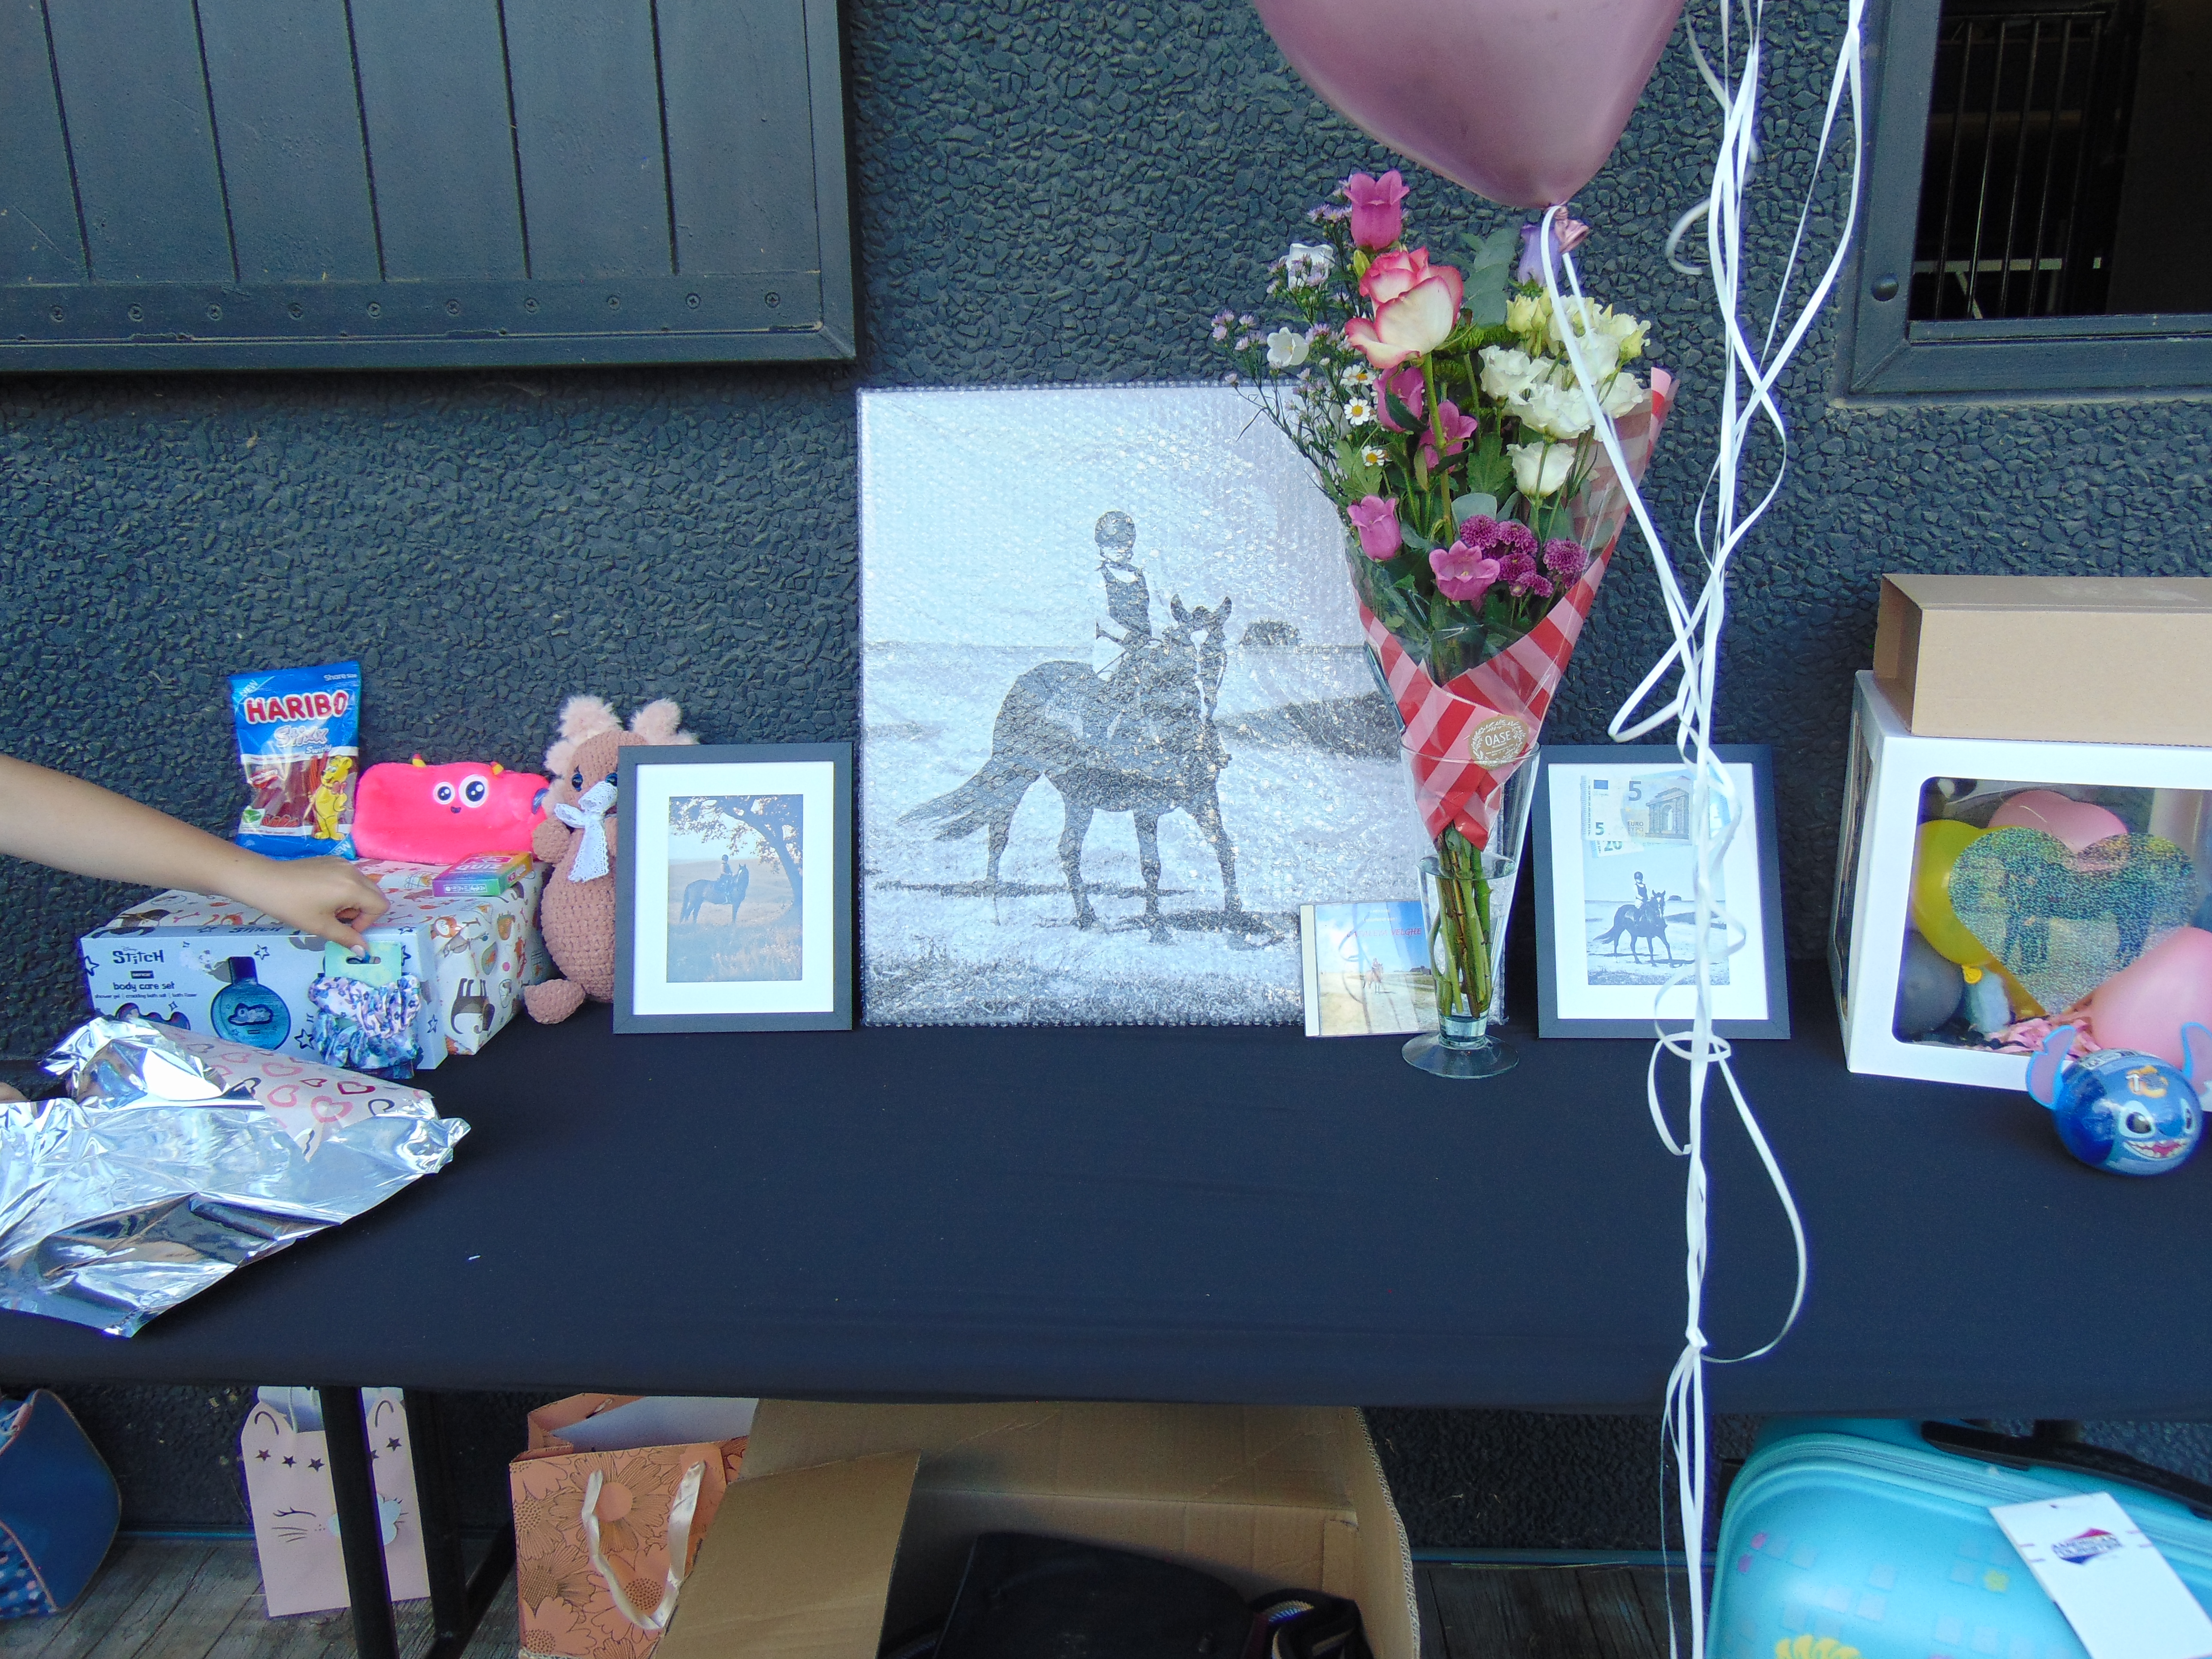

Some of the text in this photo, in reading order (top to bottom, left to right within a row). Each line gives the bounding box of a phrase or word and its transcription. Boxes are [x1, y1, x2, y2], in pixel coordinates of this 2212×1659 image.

[240, 680, 258, 697] NEW
[246, 691, 349, 724] HARIBO
[274, 725, 329, 747] Stixx
[1485, 731, 1511, 746] OASE
[305, 744, 332, 754] Swirly
[1629, 781, 1641, 801] 5
[1595, 822, 1604, 835] 5
[1604, 841, 1623, 851] 20
[1391, 928, 1422, 936] VELGHE
[112, 982, 137, 992] body
[161, 981, 175, 989] set
